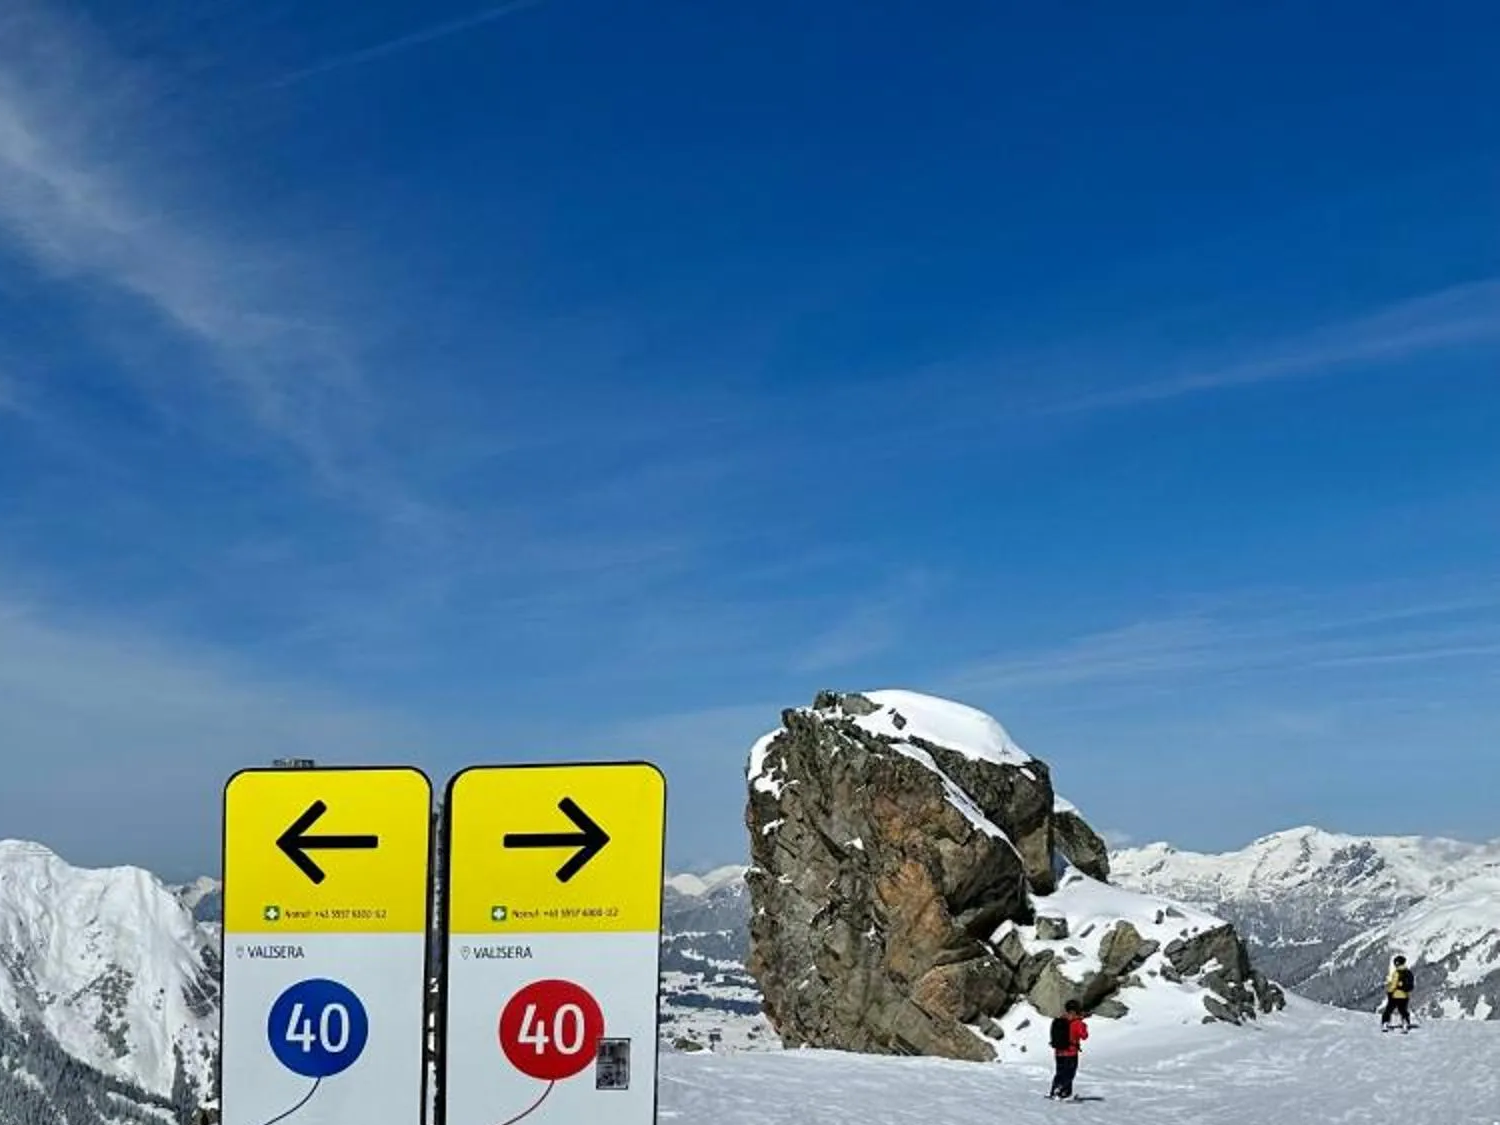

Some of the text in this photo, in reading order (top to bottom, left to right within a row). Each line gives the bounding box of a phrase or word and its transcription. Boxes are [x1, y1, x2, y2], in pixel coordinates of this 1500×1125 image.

[247, 945, 305, 959] VALISERA
[473, 945, 533, 959] VALISERA
[285, 1003, 349, 1053] 40
[517, 1003, 585, 1055] 40
